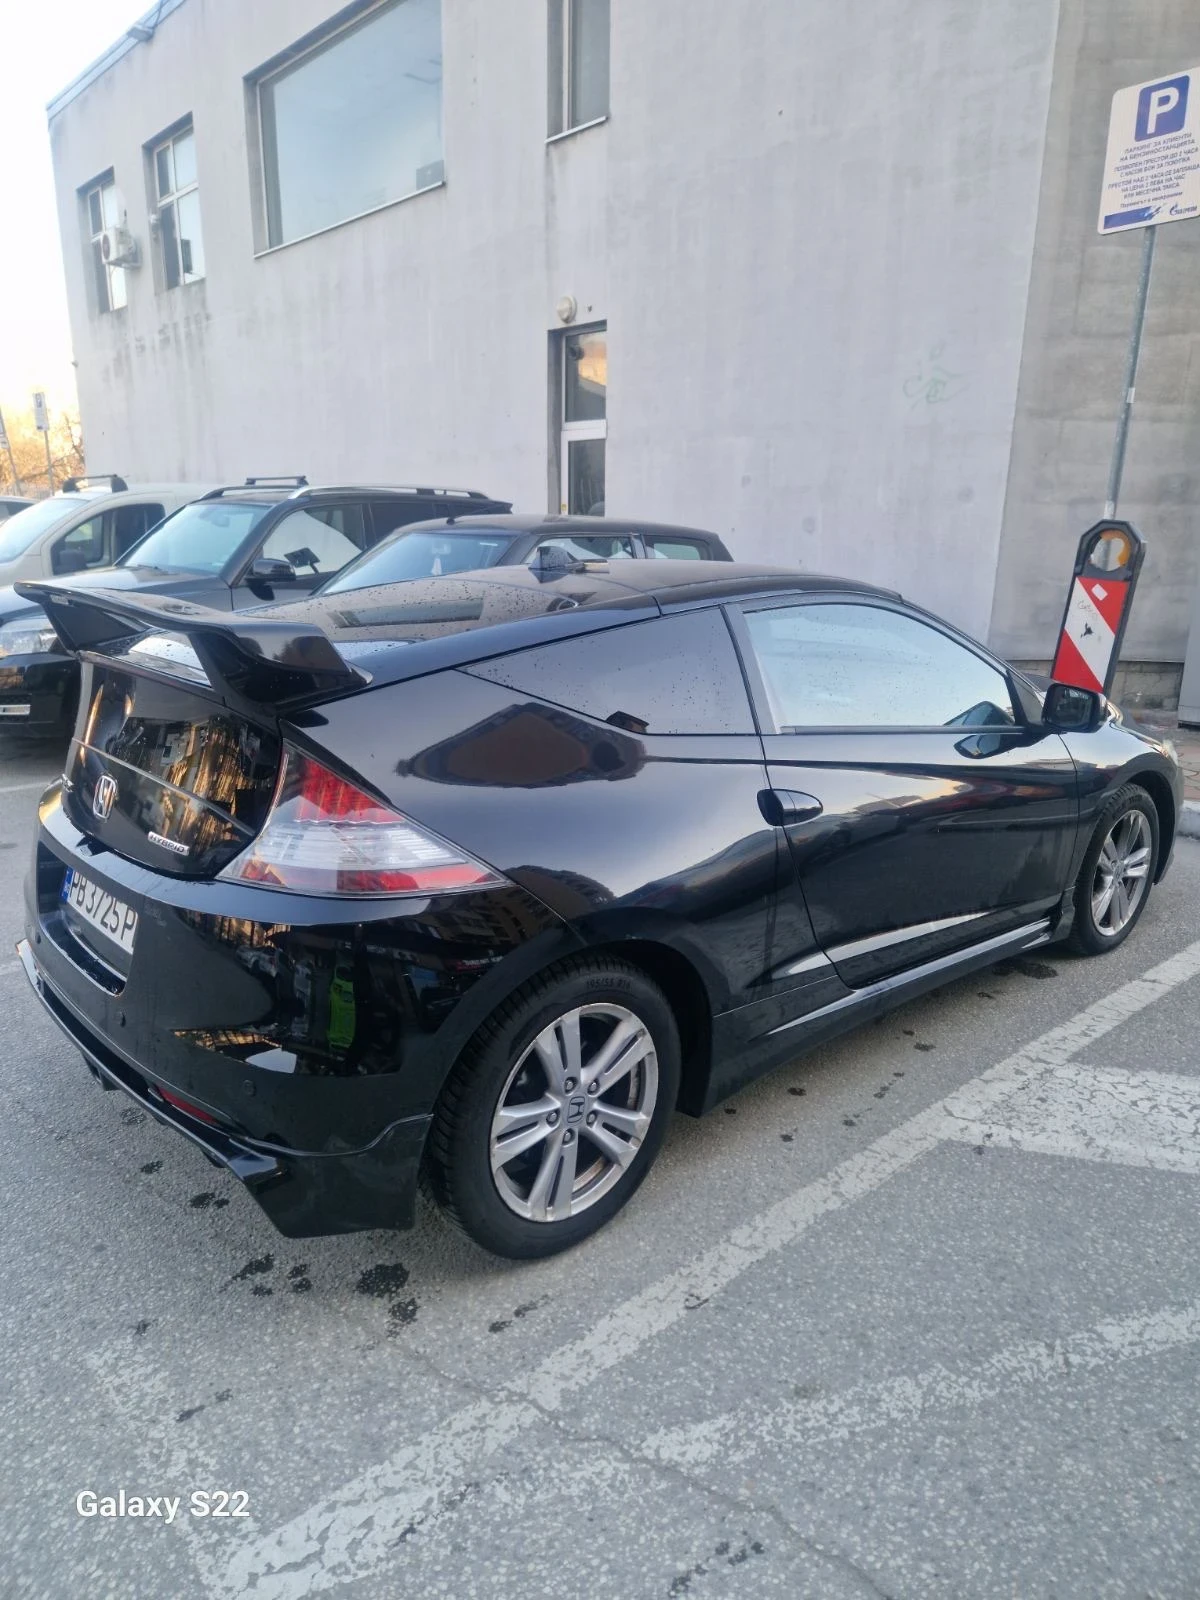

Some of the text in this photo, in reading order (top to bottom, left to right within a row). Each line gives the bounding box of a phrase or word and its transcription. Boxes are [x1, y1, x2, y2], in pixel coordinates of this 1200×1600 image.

[1147, 87, 1179, 134] P
[1125, 143, 1152, 154] ПАРКИНГ
[1163, 133, 1192, 144] КЛИЕНТИ
[1183, 147, 1198, 155] ЧАСА
[70, 871, 137, 947] PB3725P
